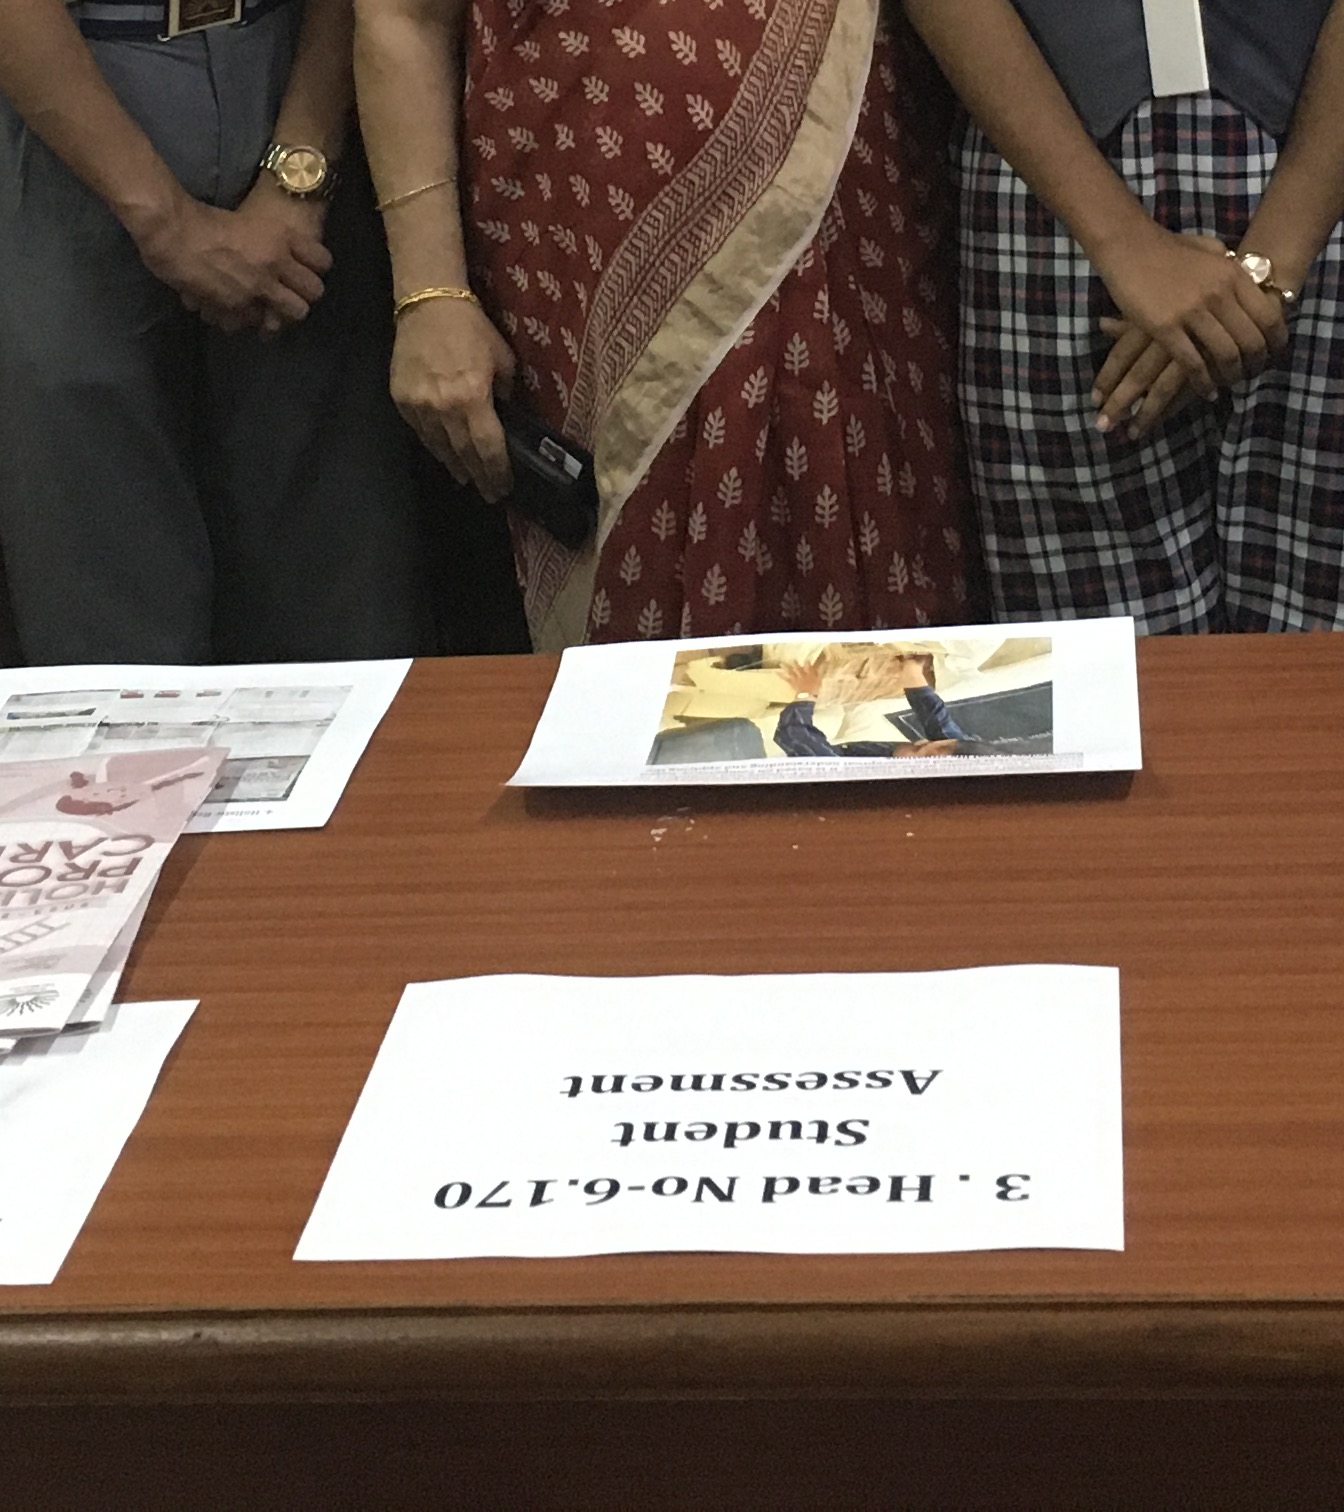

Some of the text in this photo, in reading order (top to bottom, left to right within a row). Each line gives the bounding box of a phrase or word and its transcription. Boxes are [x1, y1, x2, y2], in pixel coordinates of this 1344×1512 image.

[558, 1067, 944, 1099] Assessment
[611, 1117, 872, 1148] Student
[432, 1173, 739, 1209] No-6.170
[761, 1172, 936, 1204] Head
[995, 1172, 1032, 1202] 3
